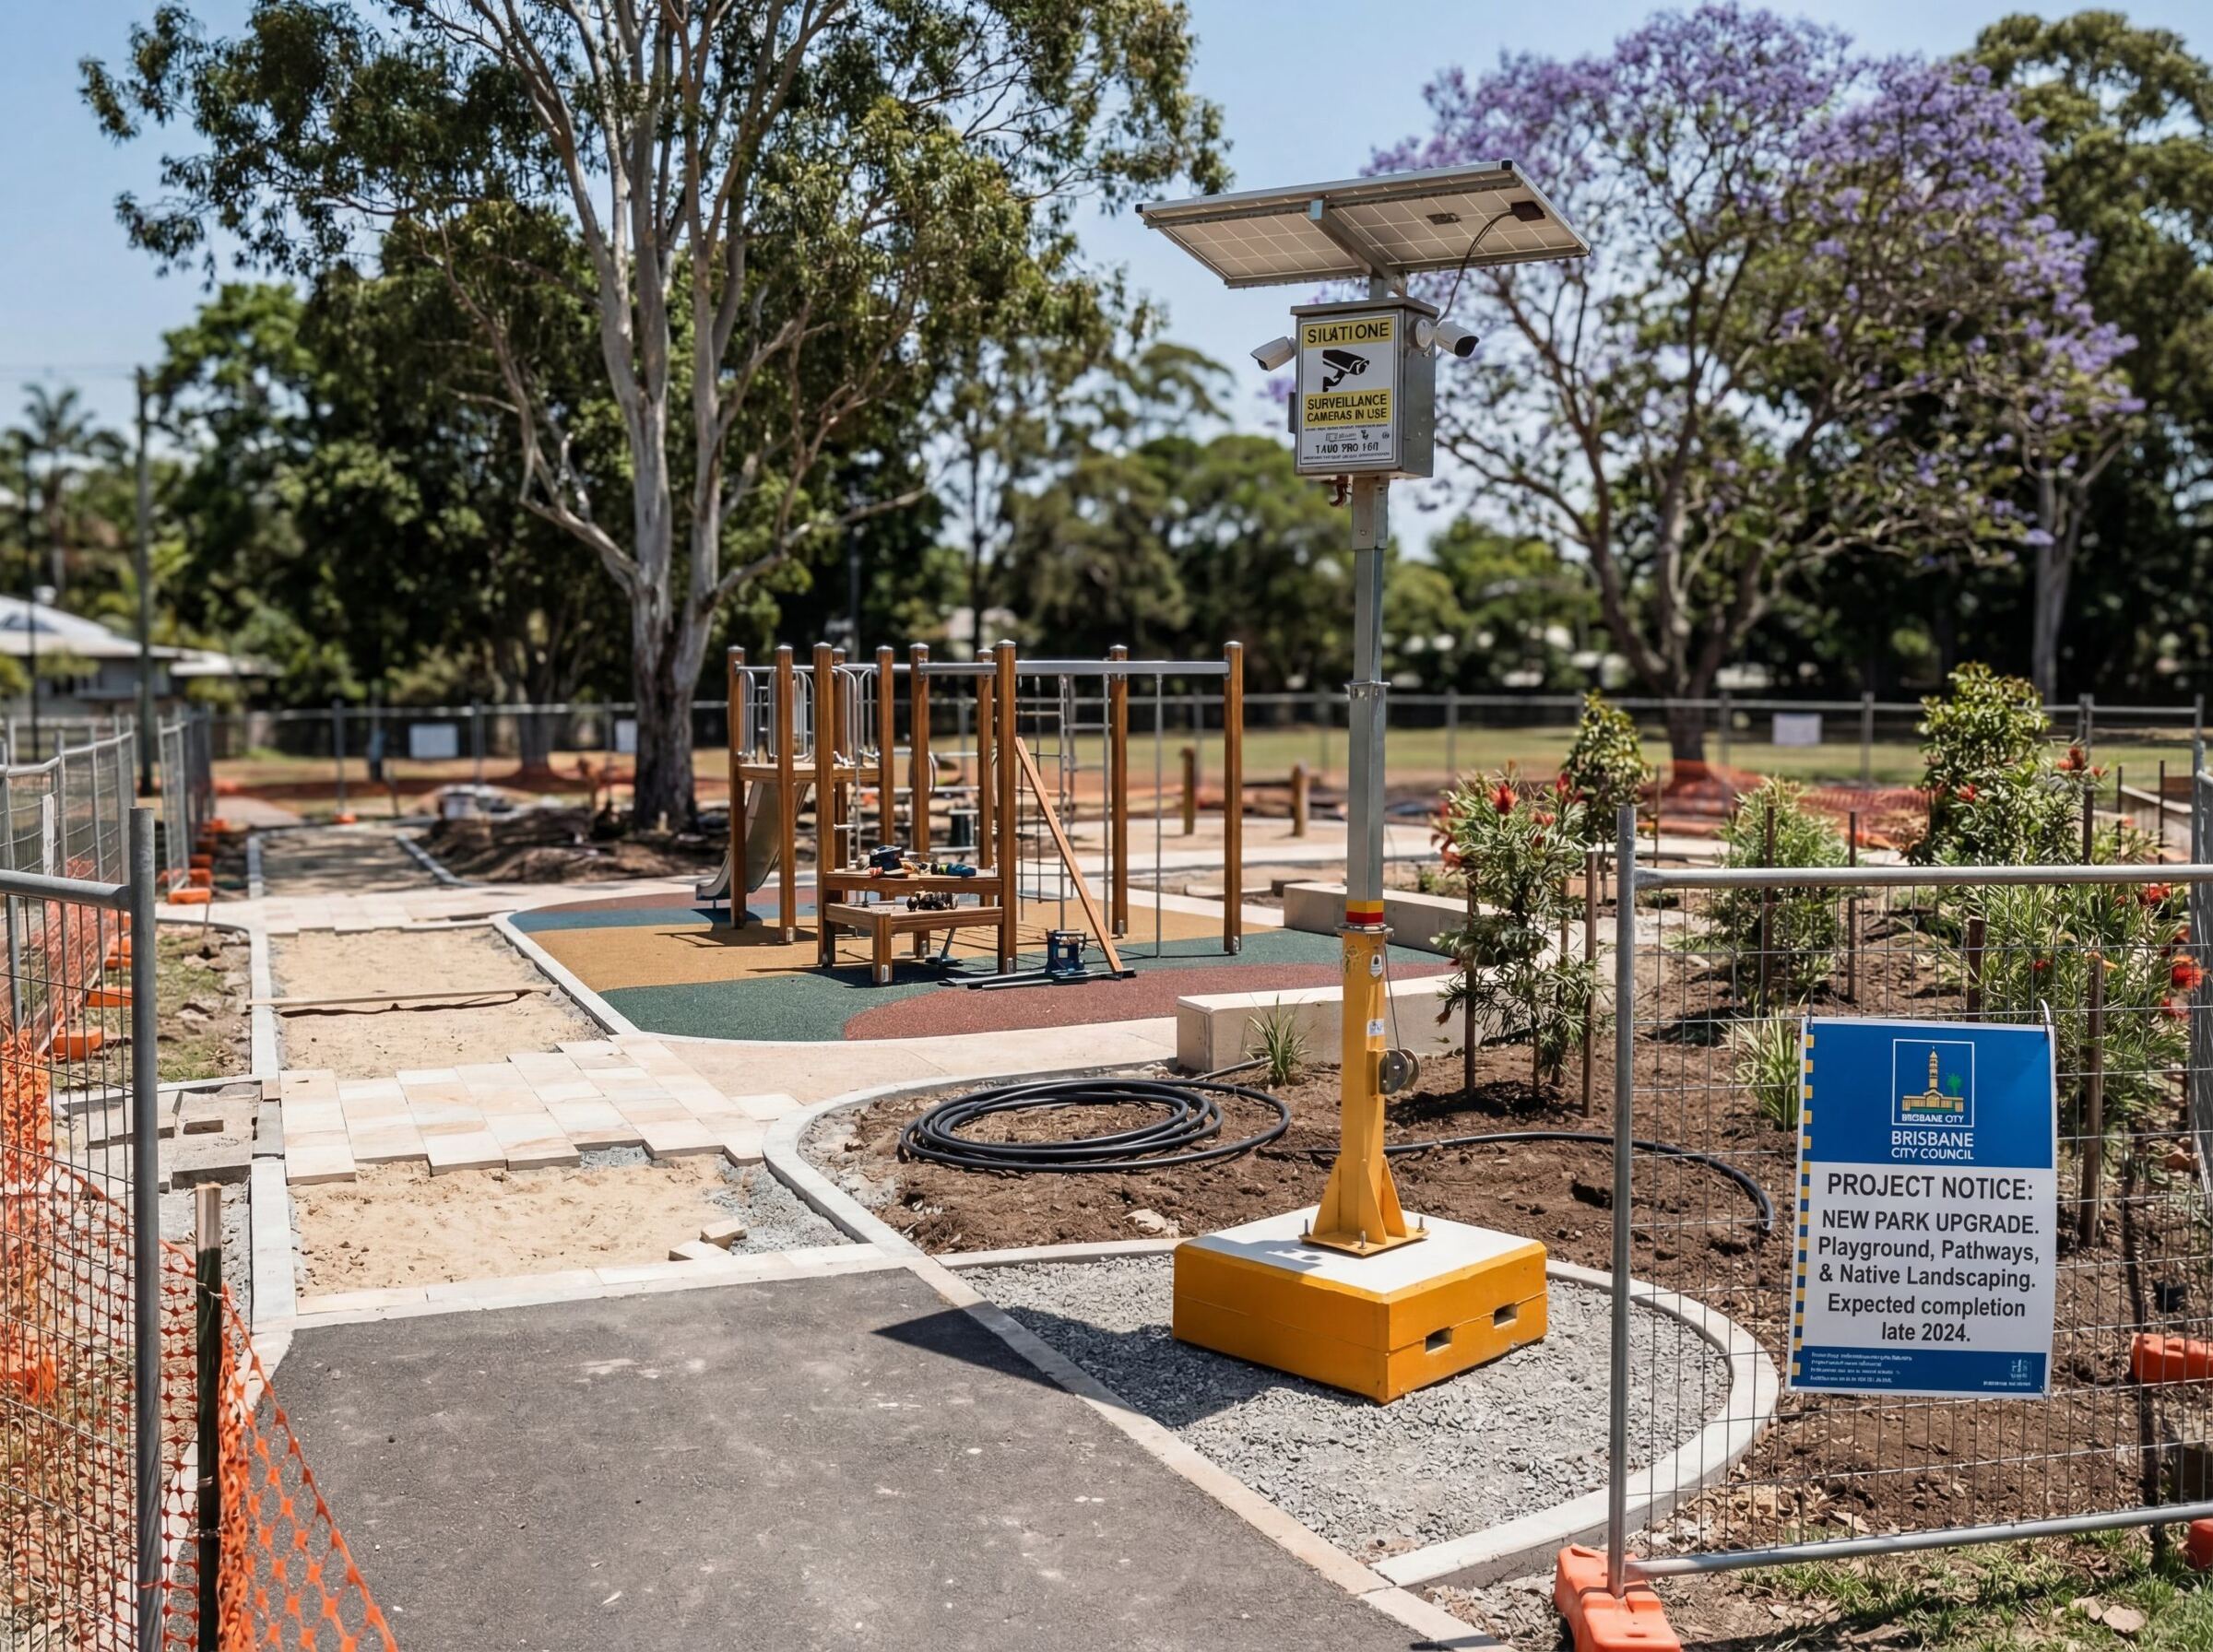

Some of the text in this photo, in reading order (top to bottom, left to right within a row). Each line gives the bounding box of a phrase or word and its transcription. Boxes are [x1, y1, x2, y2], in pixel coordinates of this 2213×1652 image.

[1308, 394, 1387, 410] SURVEILLANCE
[1307, 407, 1388, 422] CAMERAS IN USE
[1891, 1130, 1974, 1147] BRISBANE
[1891, 1147, 1974, 1160] CITY COUNCIL
[1828, 1173, 2033, 1200] PROJECT NOTICE:
[1822, 1210, 2040, 1234] NEW PARK UPGRADE.
[1818, 1235, 2039, 1265] Playground, Pathways,
[1818, 1263, 2036, 1292] & Native Landscaping.
[1828, 1292, 2026, 1320] Expected completion
[1882, 1321, 1970, 1342] late 2024.
